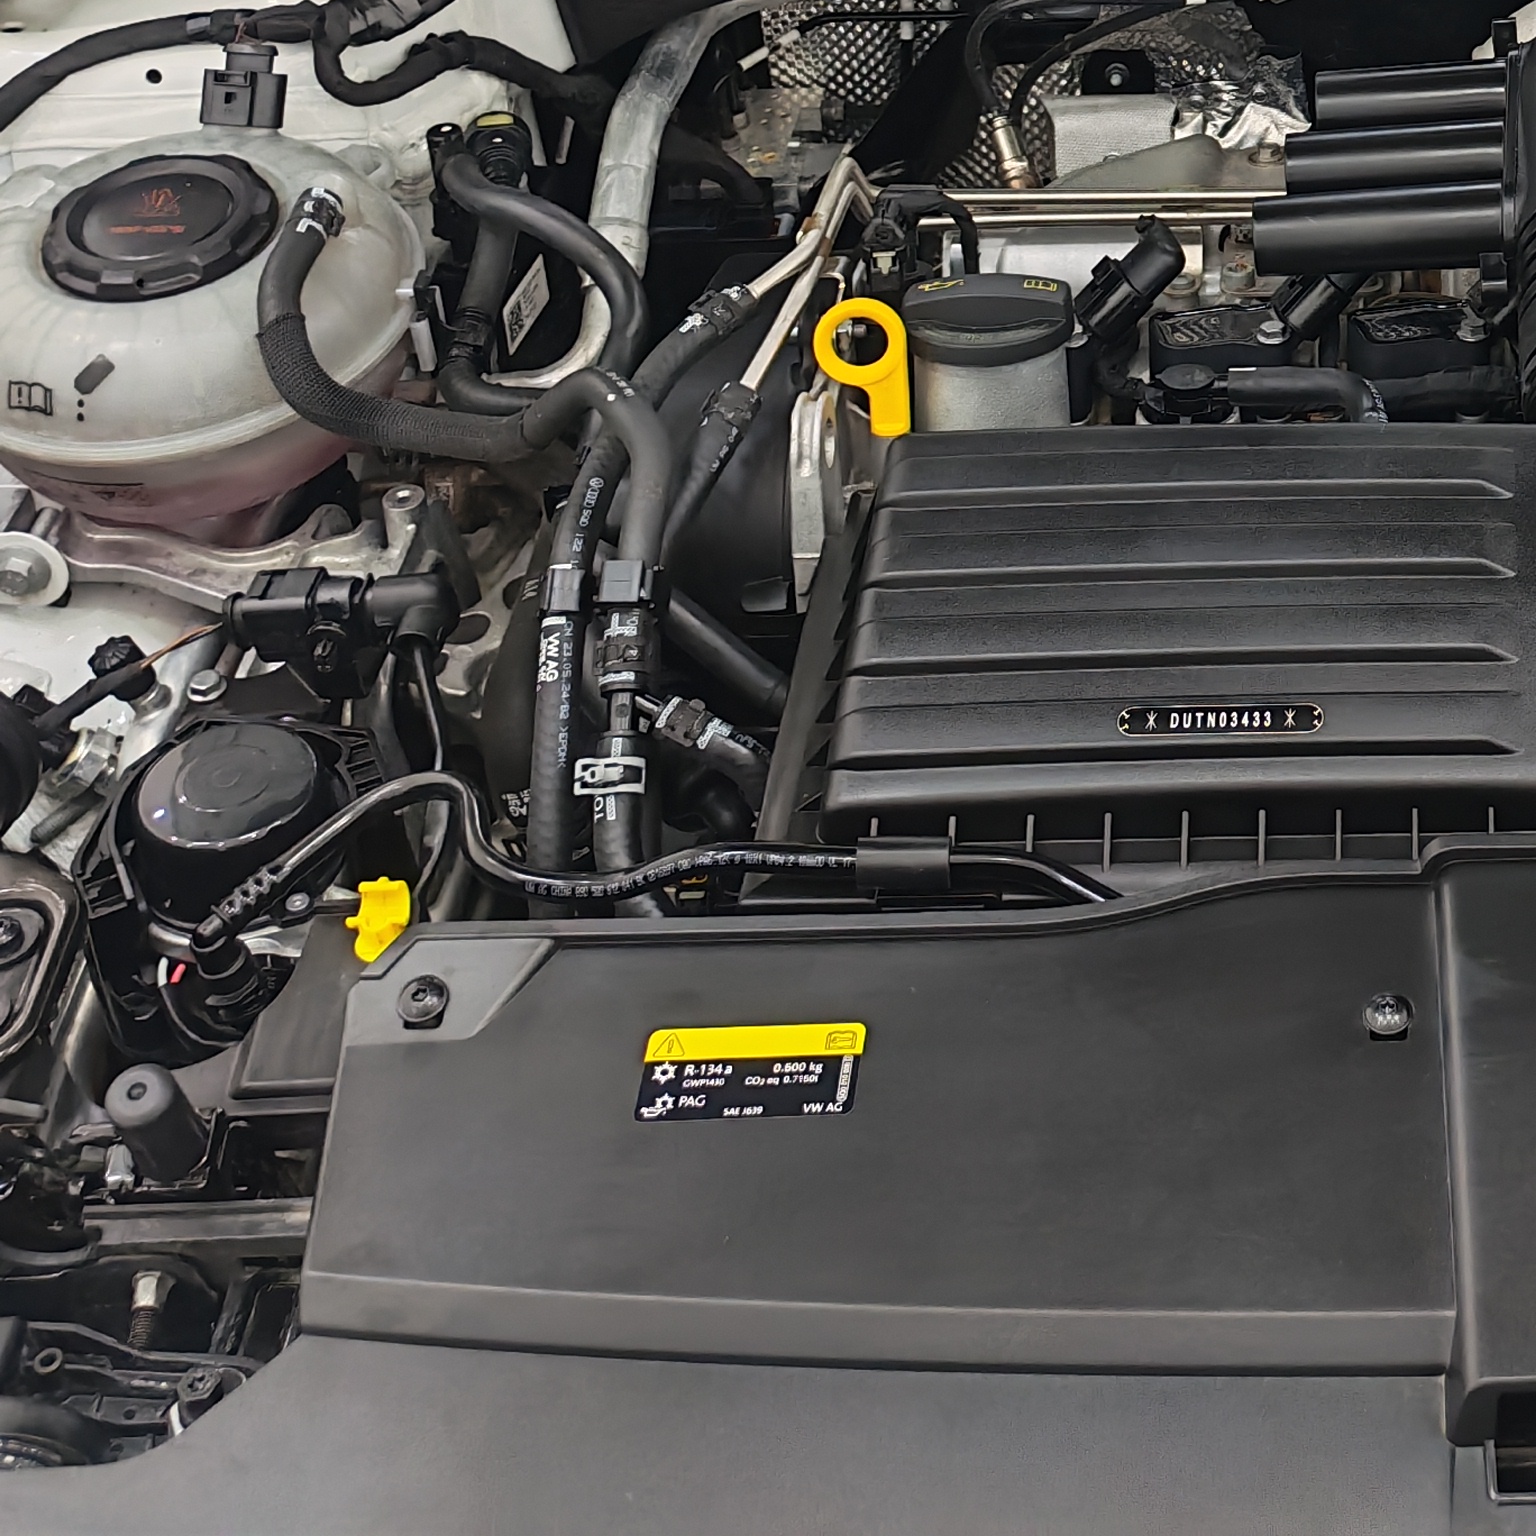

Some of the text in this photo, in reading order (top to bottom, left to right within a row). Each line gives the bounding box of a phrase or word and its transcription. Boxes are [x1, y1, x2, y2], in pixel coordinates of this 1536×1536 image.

[545, 632, 561, 683] VW AG
[1169, 711, 1272, 729] DUTN03433
[808, 1061, 824, 1074] kg
[682, 1077, 726, 1088] GWP1430
[677, 1094, 706, 1108] PAG
[803, 1102, 843, 1113] VW AG
[722, 1107, 741, 1117] SAE
